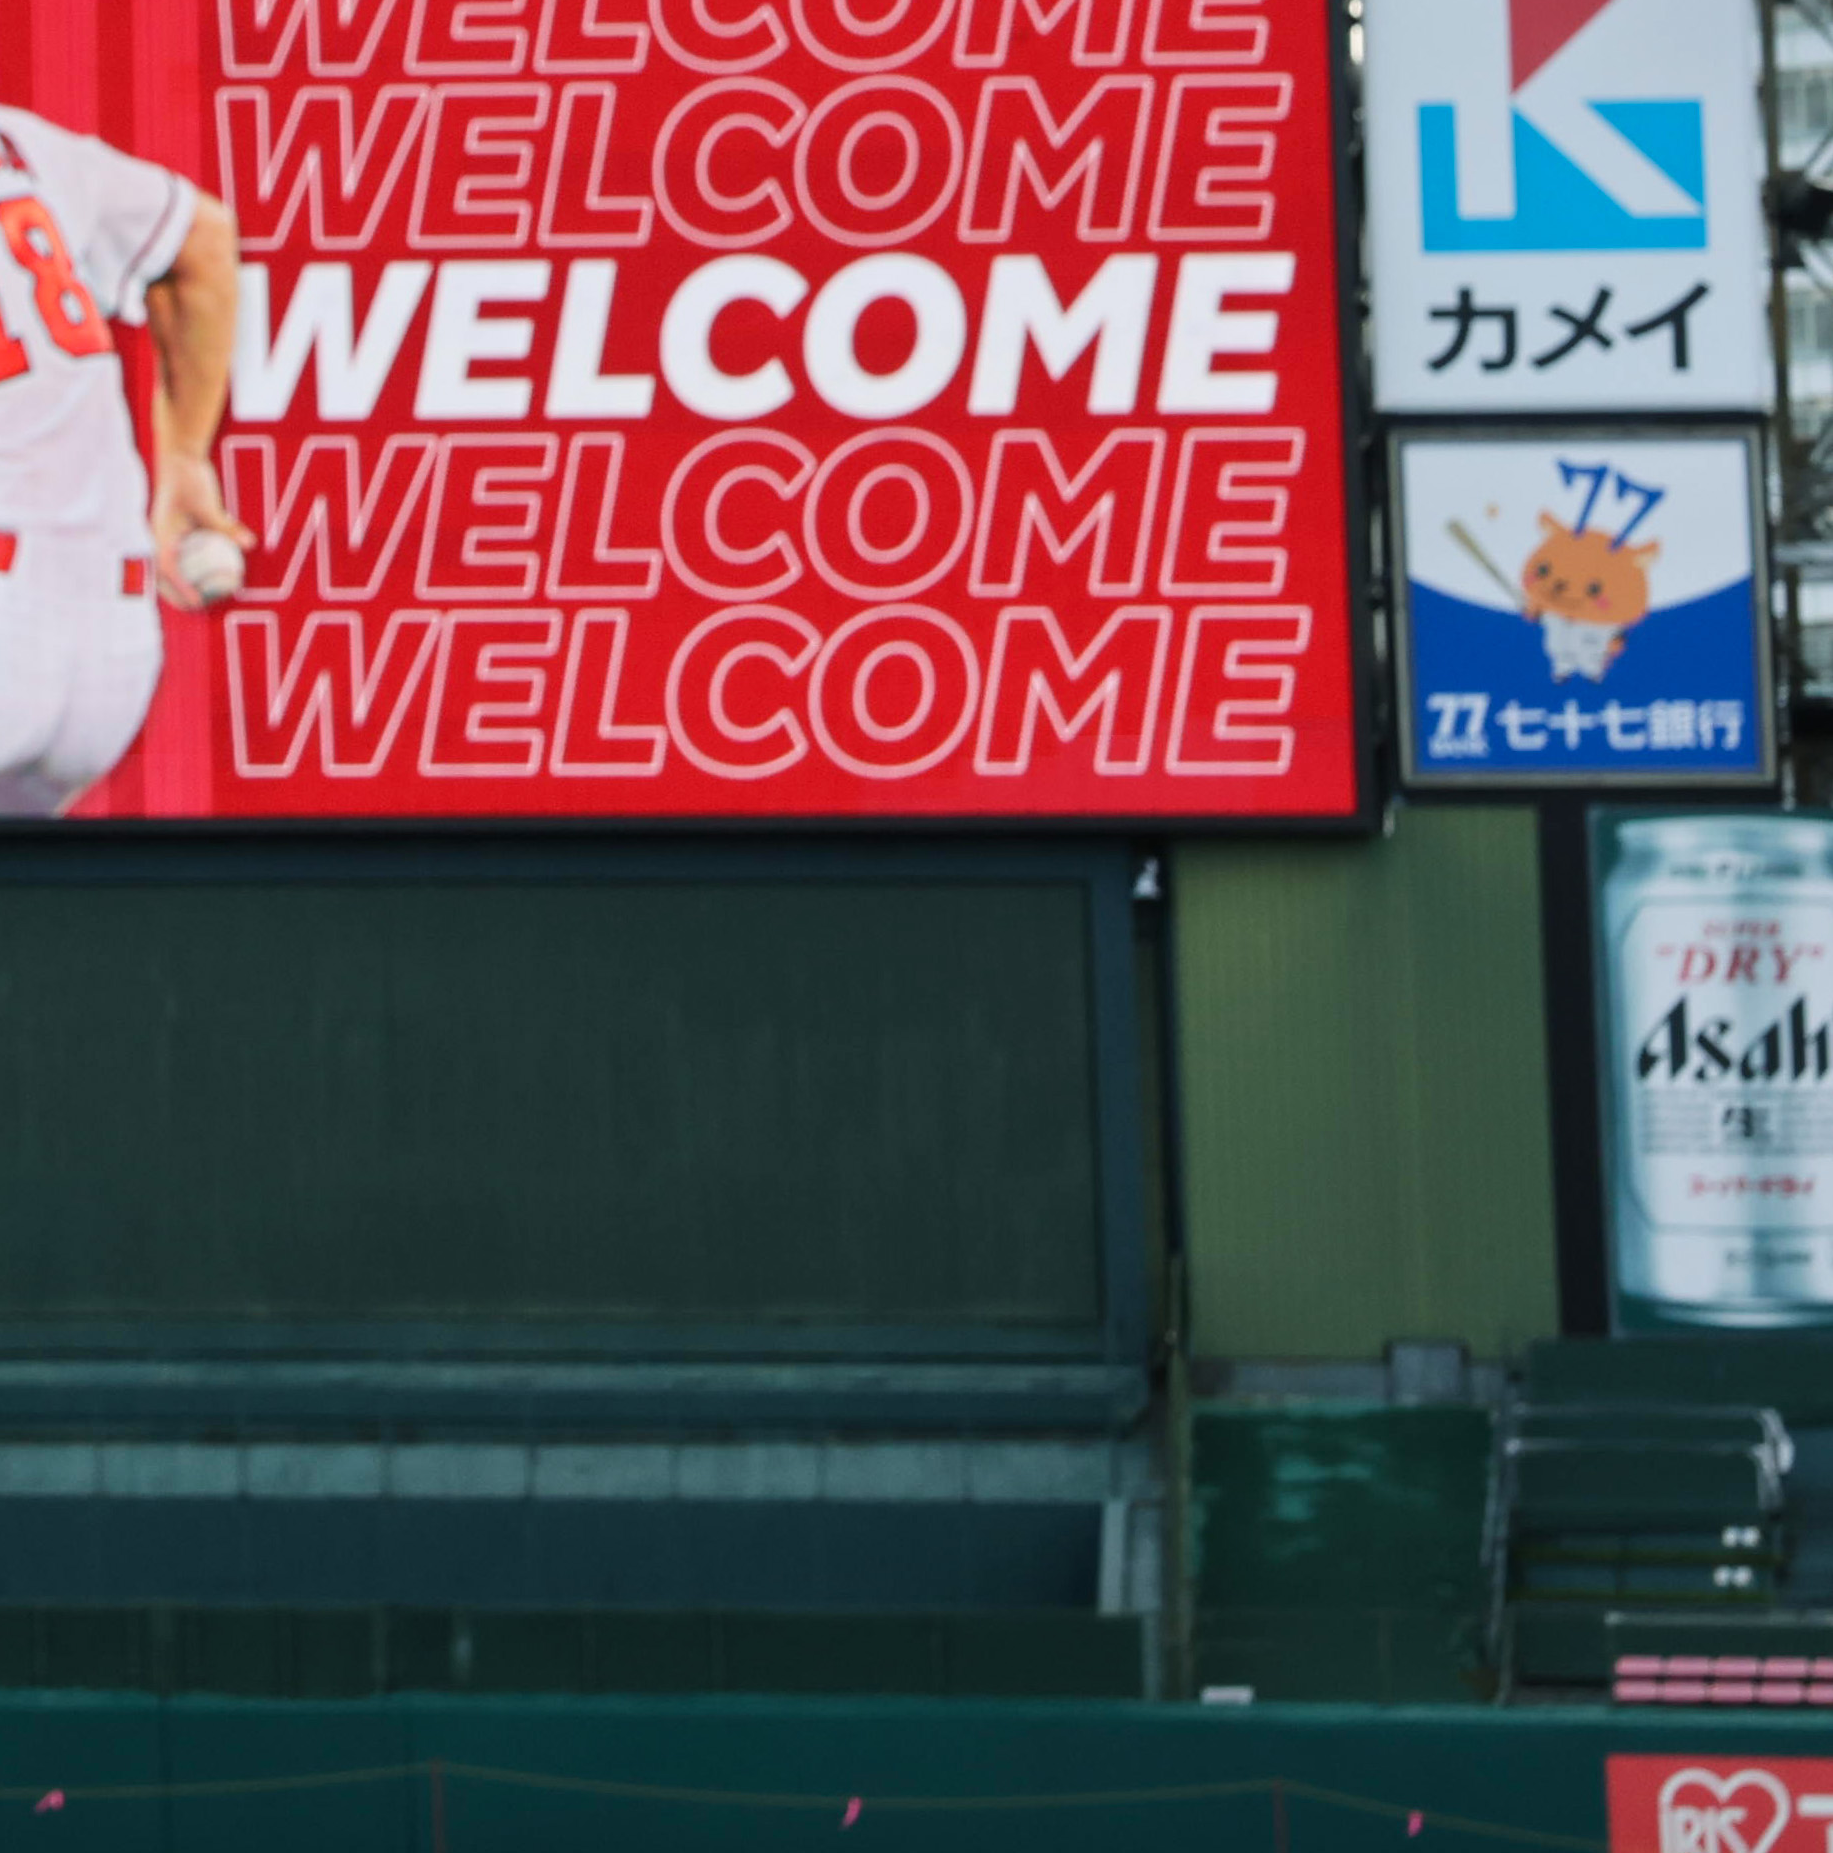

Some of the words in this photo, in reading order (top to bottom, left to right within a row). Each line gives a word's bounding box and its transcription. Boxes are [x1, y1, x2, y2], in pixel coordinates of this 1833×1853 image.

[214, 72, 1293, 251] WELCOME
[230, 250, 1297, 424] WELCOME
[1426, 282, 1712, 373] カメイ
[221, 425, 1306, 602] WELCOME
[224, 602, 1312, 781] WELCOME
[1426, 693, 1491, 739] 77
[1637, 993, 1833, 1081] Asah
